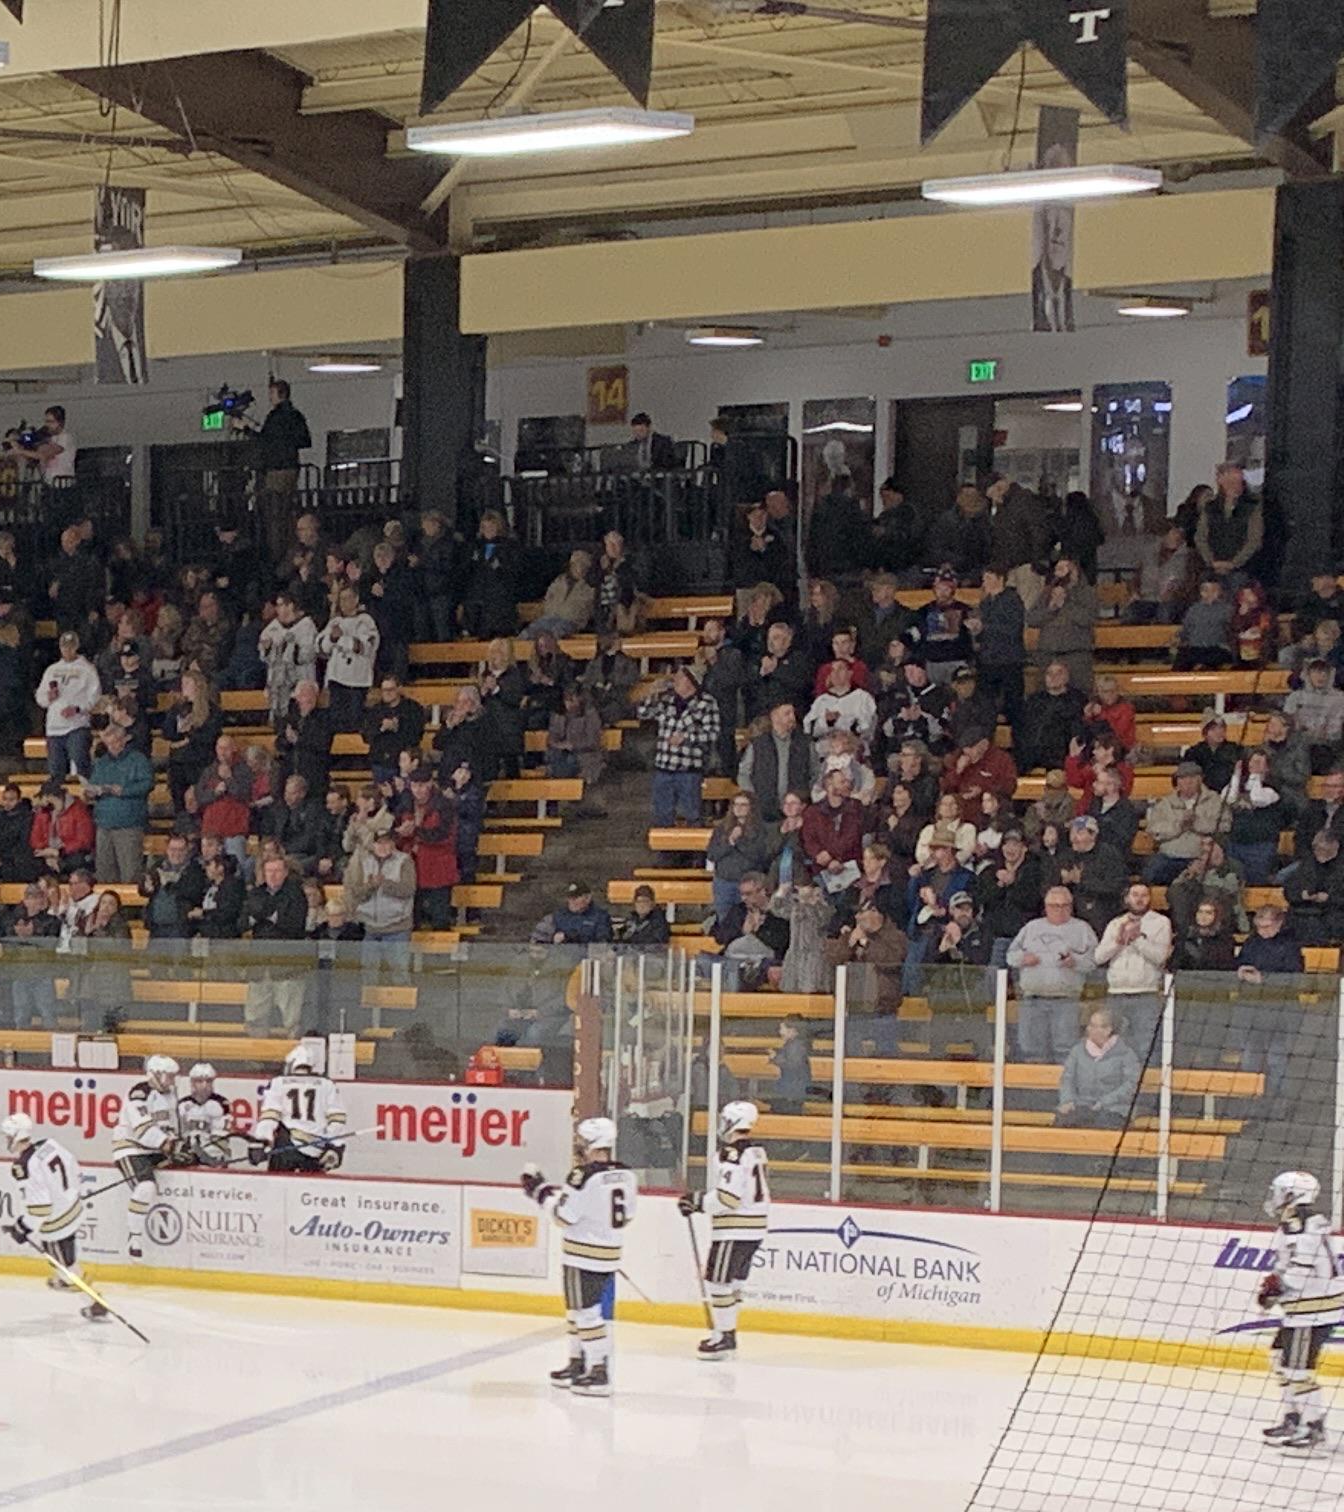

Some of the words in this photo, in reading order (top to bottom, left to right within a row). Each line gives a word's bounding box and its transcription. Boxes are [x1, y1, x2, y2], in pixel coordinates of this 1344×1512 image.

[8, 1078, 123, 1139] meije
[286, 1088, 317, 1122] 11
[376, 1092, 529, 1157] meijer
[47, 1155, 69, 1192] 7
[156, 1183, 194, 1198] Local
[200, 1188, 257, 1201] service.
[301, 1192, 346, 1208] Great
[358, 1196, 447, 1214] insurance.
[186, 1210, 263, 1233] NULTY
[610, 1188, 626, 1229] 6
[290, 1215, 451, 1245] Auto-Owners
[477, 1217, 533, 1236] DICKEY'S
[186, 1232, 264, 1249] INSURANCE
[325, 1243, 413, 1256] INSURANCE
[786, 1250, 906, 1278] NATIONAL
[914, 1258, 982, 1283] BANK
[877, 1283, 895, 1299] of
[898, 1283, 981, 1306] Michigan
